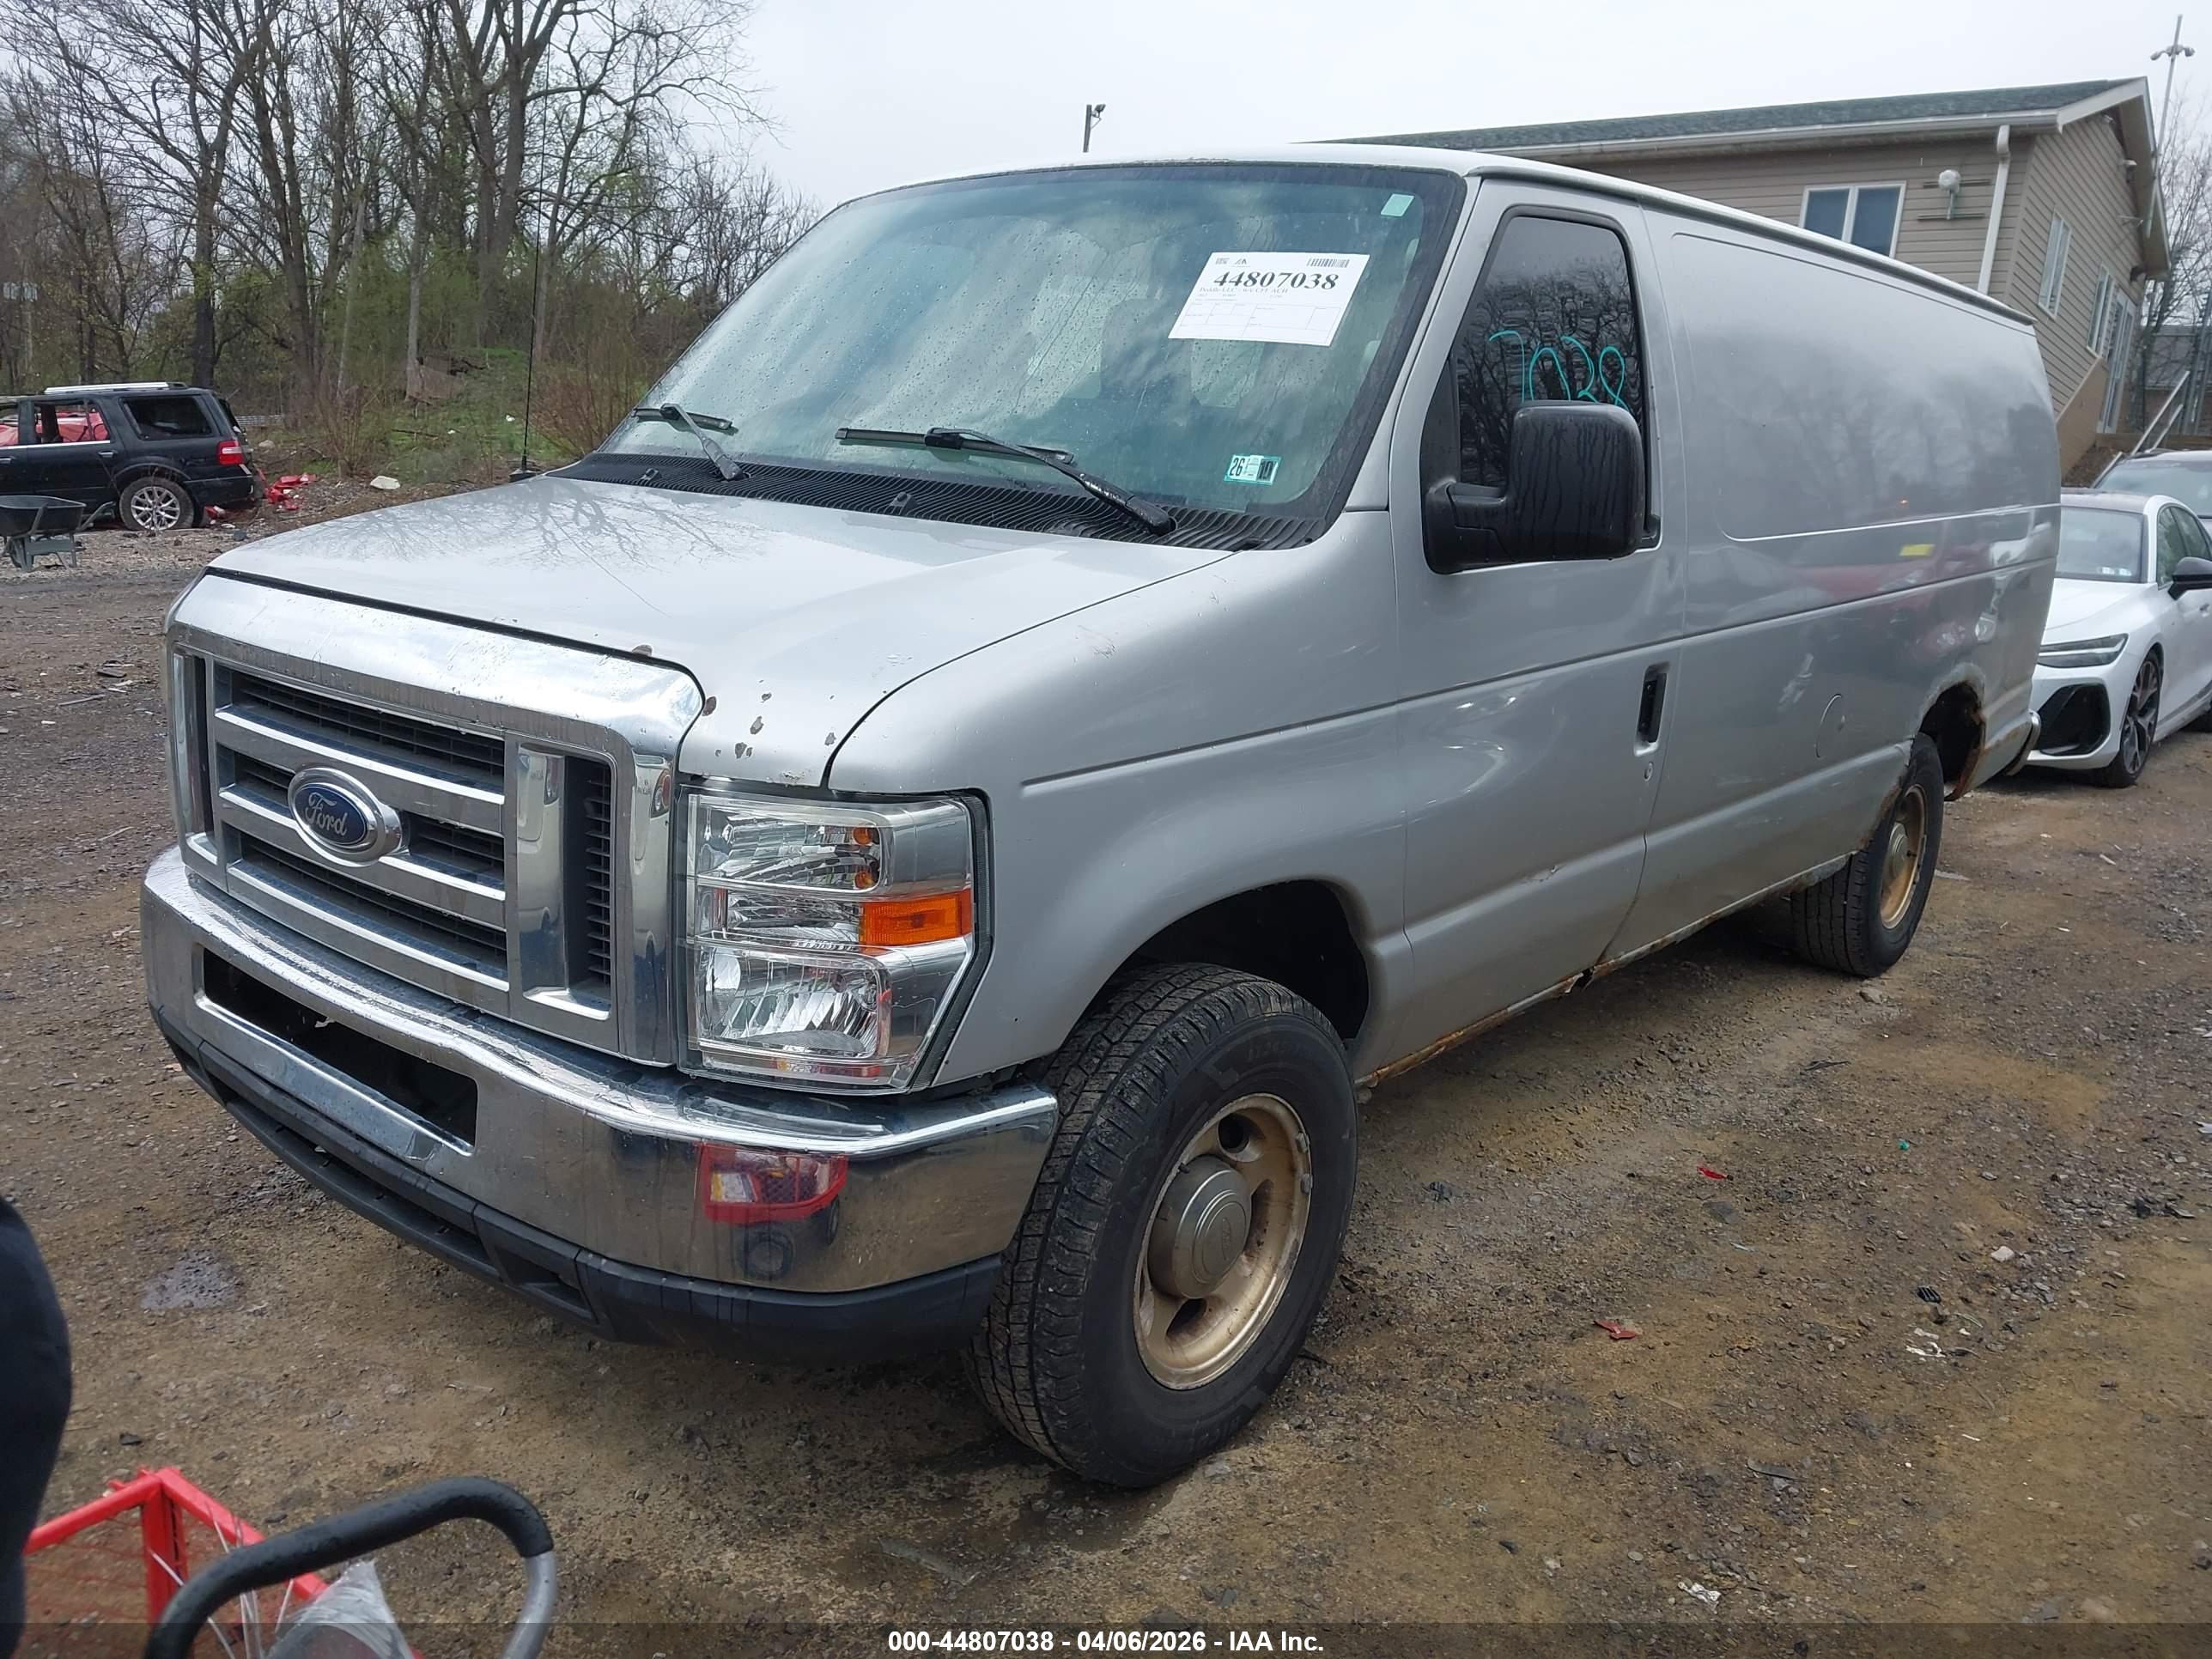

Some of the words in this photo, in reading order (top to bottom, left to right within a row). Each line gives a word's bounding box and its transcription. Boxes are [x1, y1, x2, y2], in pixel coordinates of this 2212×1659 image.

[1213, 270, 1340, 290] 44807038
[1229, 457, 1246, 477] 26
[304, 791, 348, 836] Ford
